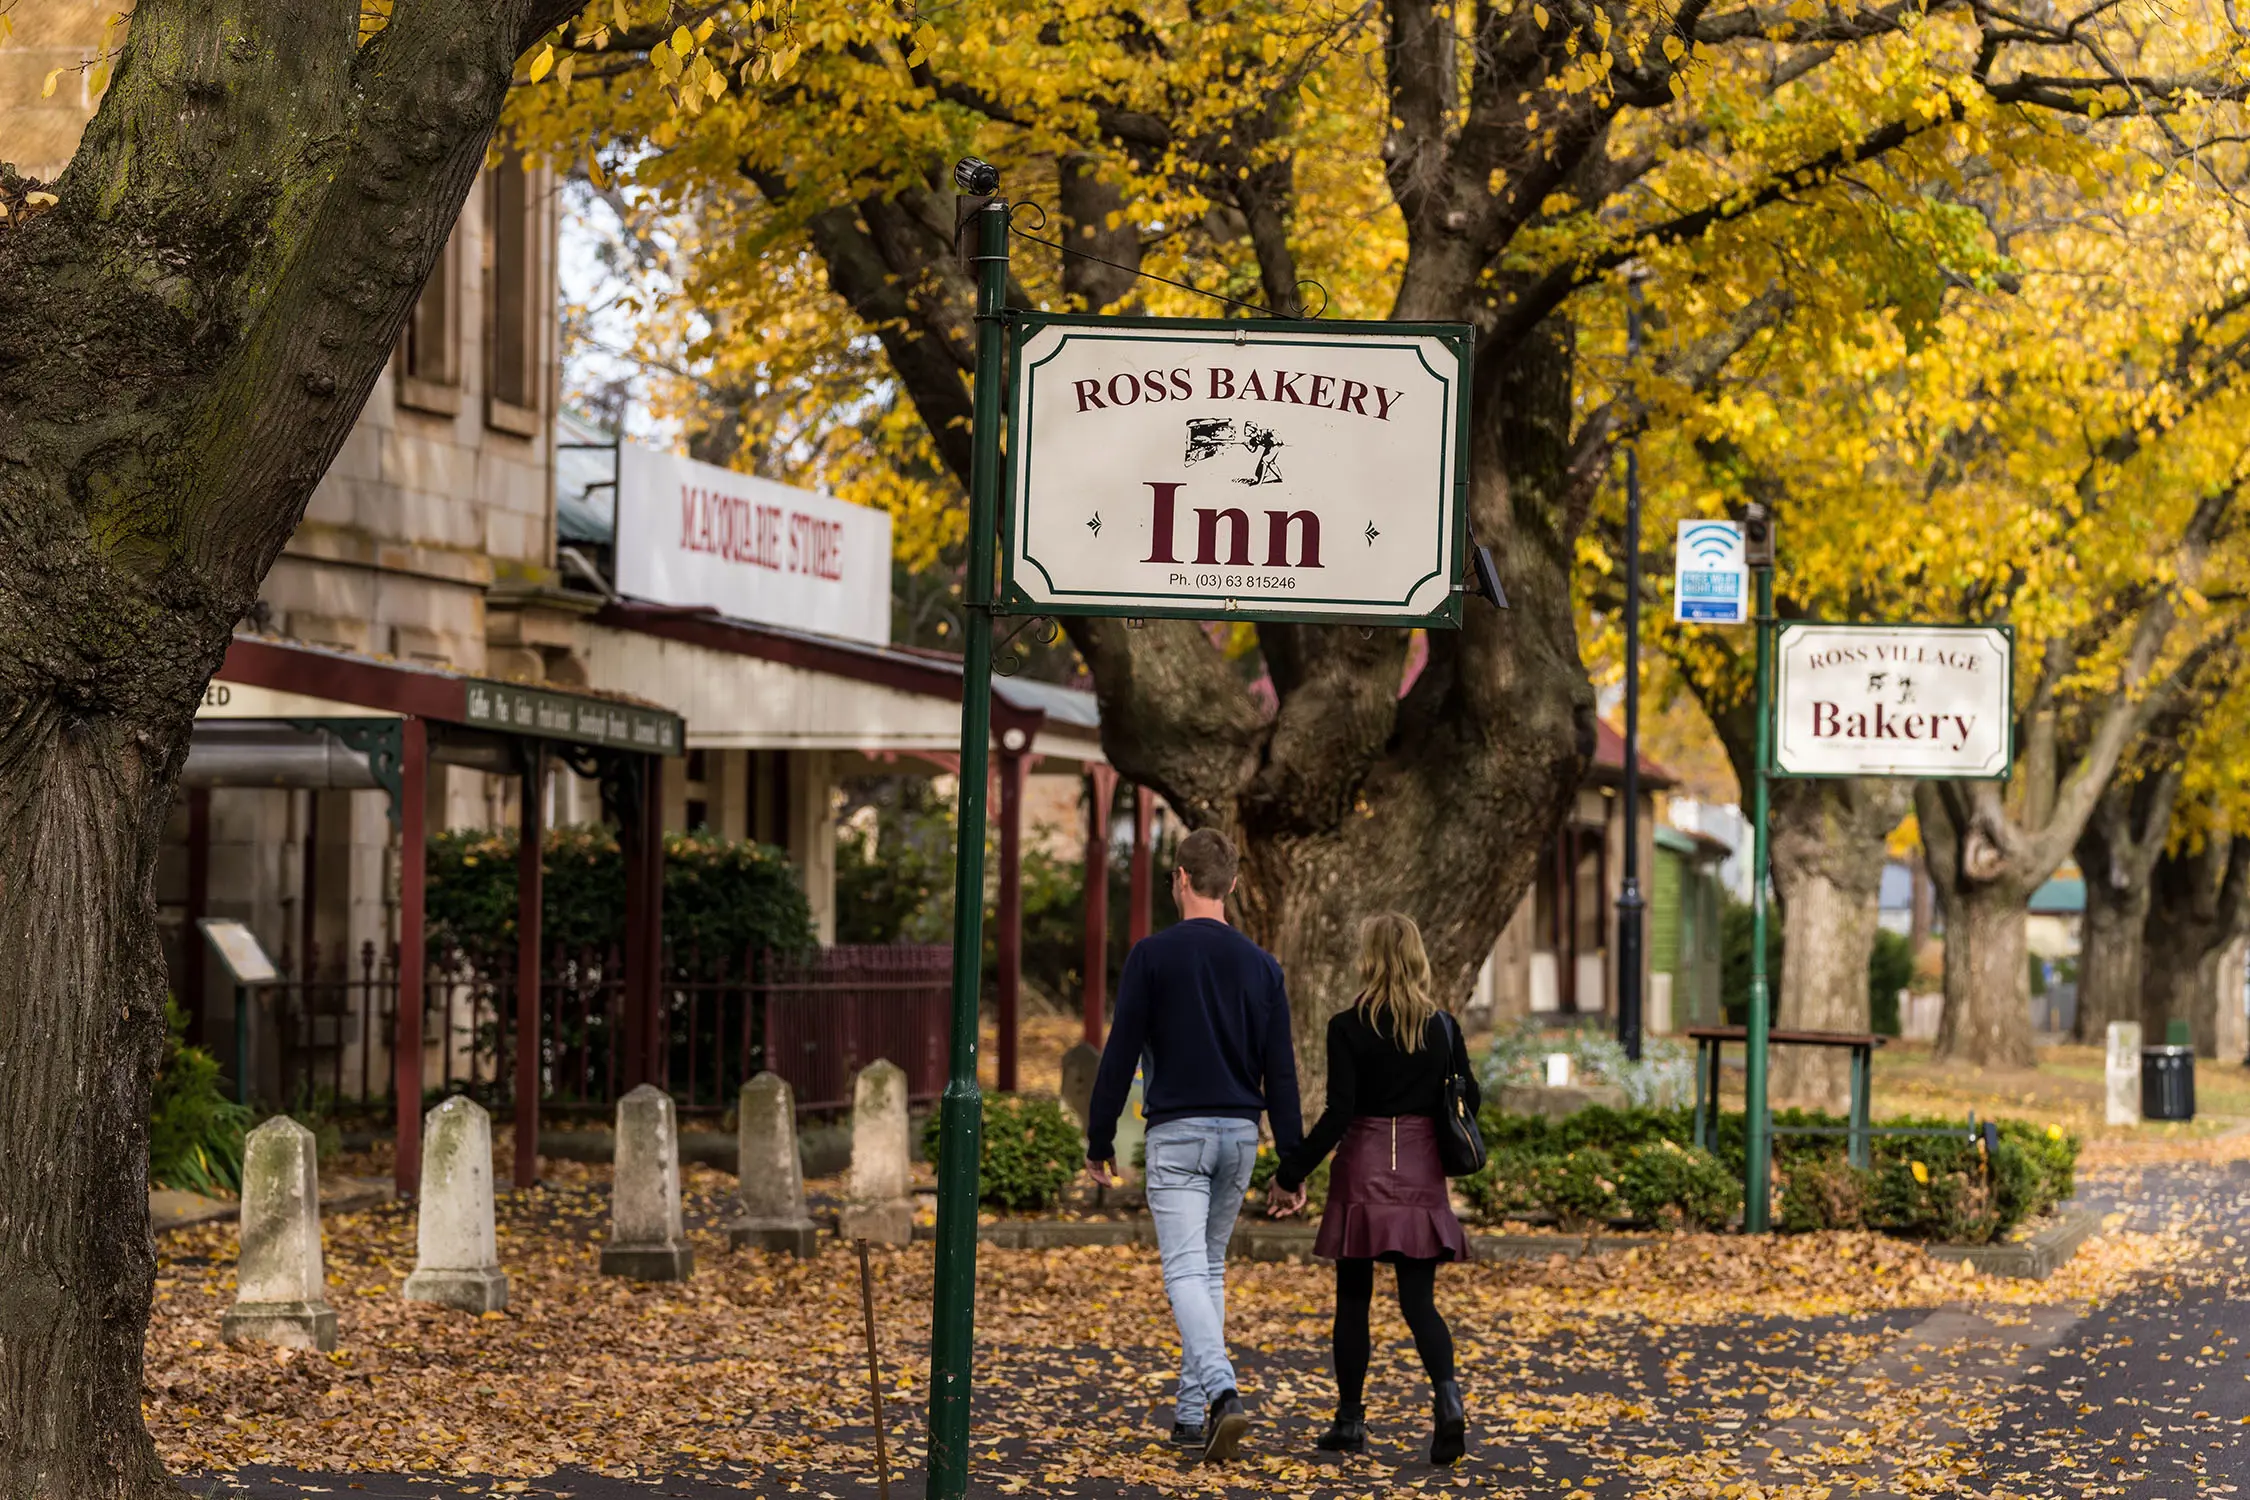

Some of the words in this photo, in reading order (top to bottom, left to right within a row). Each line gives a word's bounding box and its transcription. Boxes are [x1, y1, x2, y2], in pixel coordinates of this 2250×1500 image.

[1072, 368, 1193, 413] ROSS
[1206, 367, 1405, 421] BAKERY
[788, 511, 843, 582] STORE
[1140, 482, 1325, 568] Inn
[1169, 573, 1191, 586] Ph.
[1195, 574, 1222, 590] (03)
[1225, 575, 1243, 588] 63
[1246, 576, 1296, 590] 815246
[1809, 646, 1869, 670] ROSS
[1876, 645, 1983, 673] VILLAGE
[1812, 701, 1976, 751] Bakery
